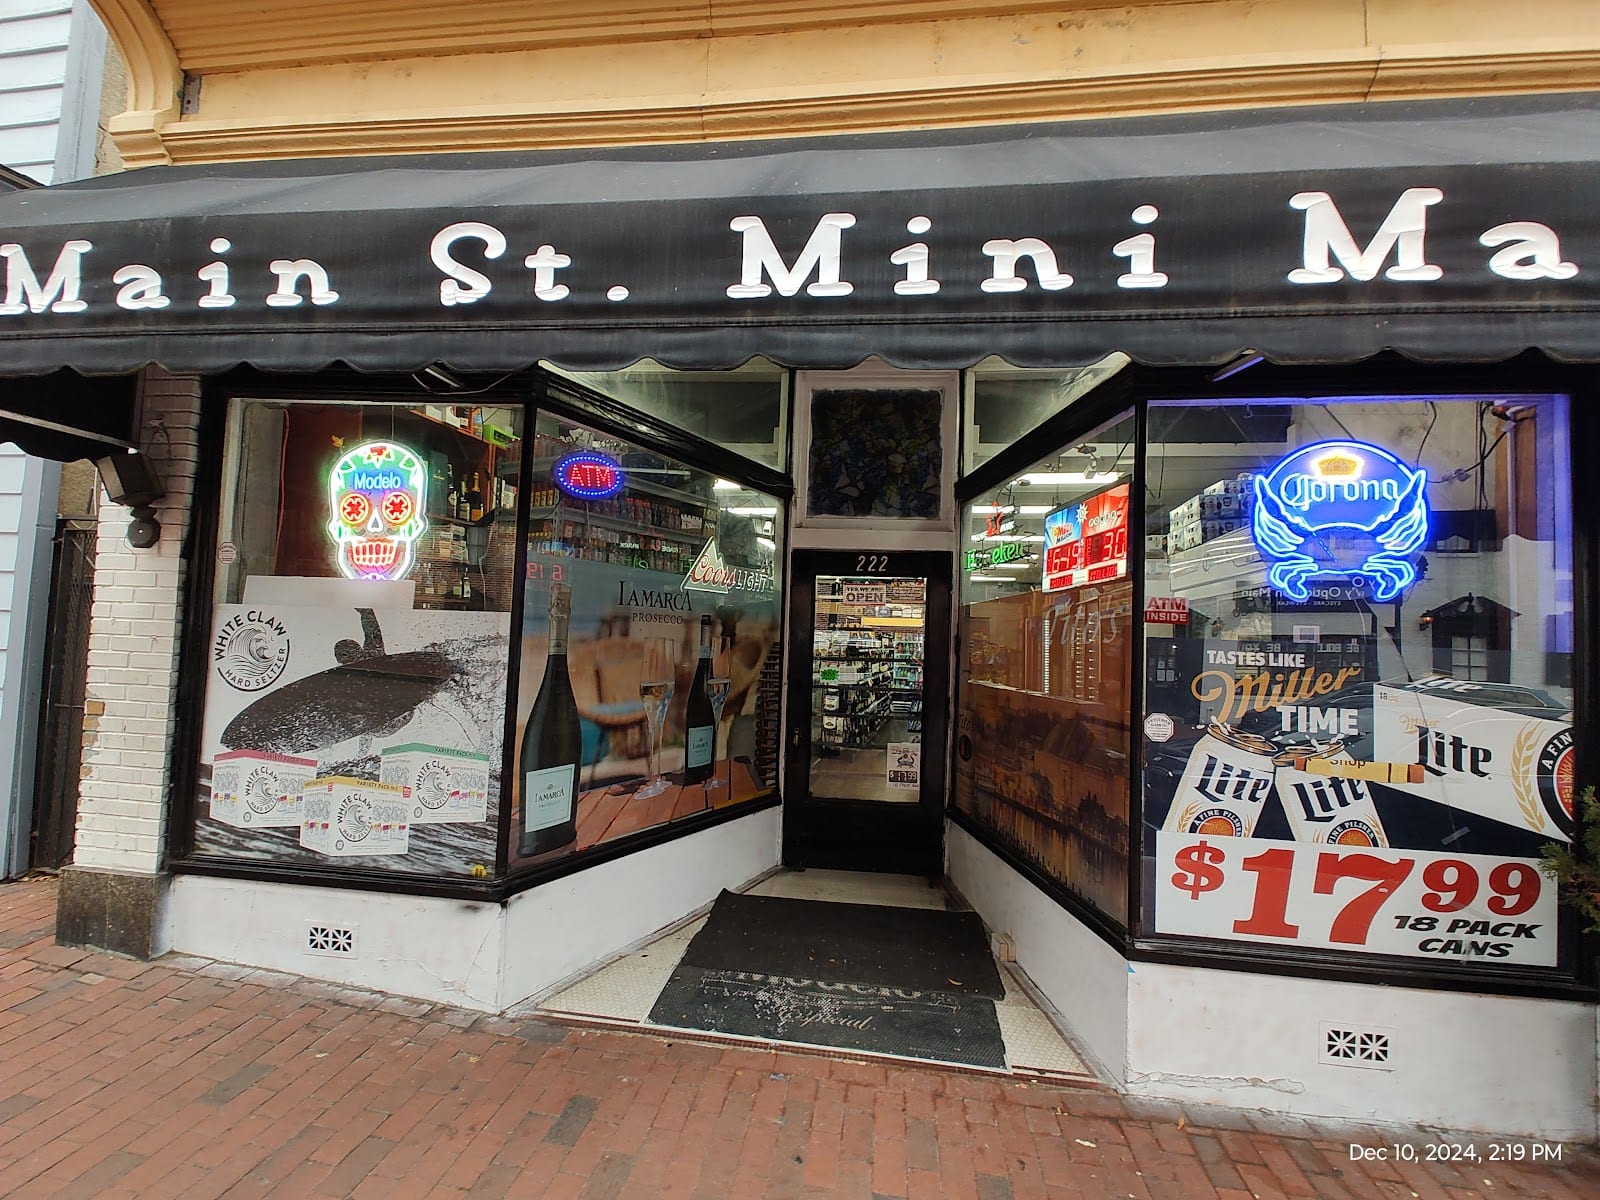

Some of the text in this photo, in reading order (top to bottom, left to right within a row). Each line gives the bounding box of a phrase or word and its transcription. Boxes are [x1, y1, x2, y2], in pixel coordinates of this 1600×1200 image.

[0, 238, 340, 314] Main
[431, 221, 630, 306] St.
[725, 203, 1169, 299] Mini
[354, 472, 401, 490] Modelo
[570, 465, 611, 487] ATM
[1280, 473, 1400, 511] Corona
[1102, 528, 1126, 560] 30
[691, 553, 736, 589] Coors
[736, 569, 768, 592] LIGHT
[856, 555, 888, 571] 222
[846, 593, 883, 602] OPEN
[1147, 597, 1186, 610] ATM
[632, 612, 684, 624] PROSECCO
[1146, 612, 1187, 621] INSIDE
[214, 610, 287, 661] WHITE CLAW
[225, 648, 286, 687] HARD SELTZER
[1206, 650, 1305, 668] TASTES LIKE
[1191, 666, 1361, 723] Miller
[1276, 705, 1359, 736] TIME
[1414, 725, 1492, 777] Lite
[244, 766, 280, 796] WHITE CLAW
[415, 760, 451, 791] WHITE CLAW
[1193, 753, 1270, 803] Lite
[337, 793, 373, 824] WHITE CLAW
[1200, 808, 1220, 820] FINE
[1290, 776, 1366, 822] Lite
[1344, 821, 1375, 840] PILSNER
[1394, 915, 1543, 939] 18 PACK
[1418, 938, 1514, 958] CANS
